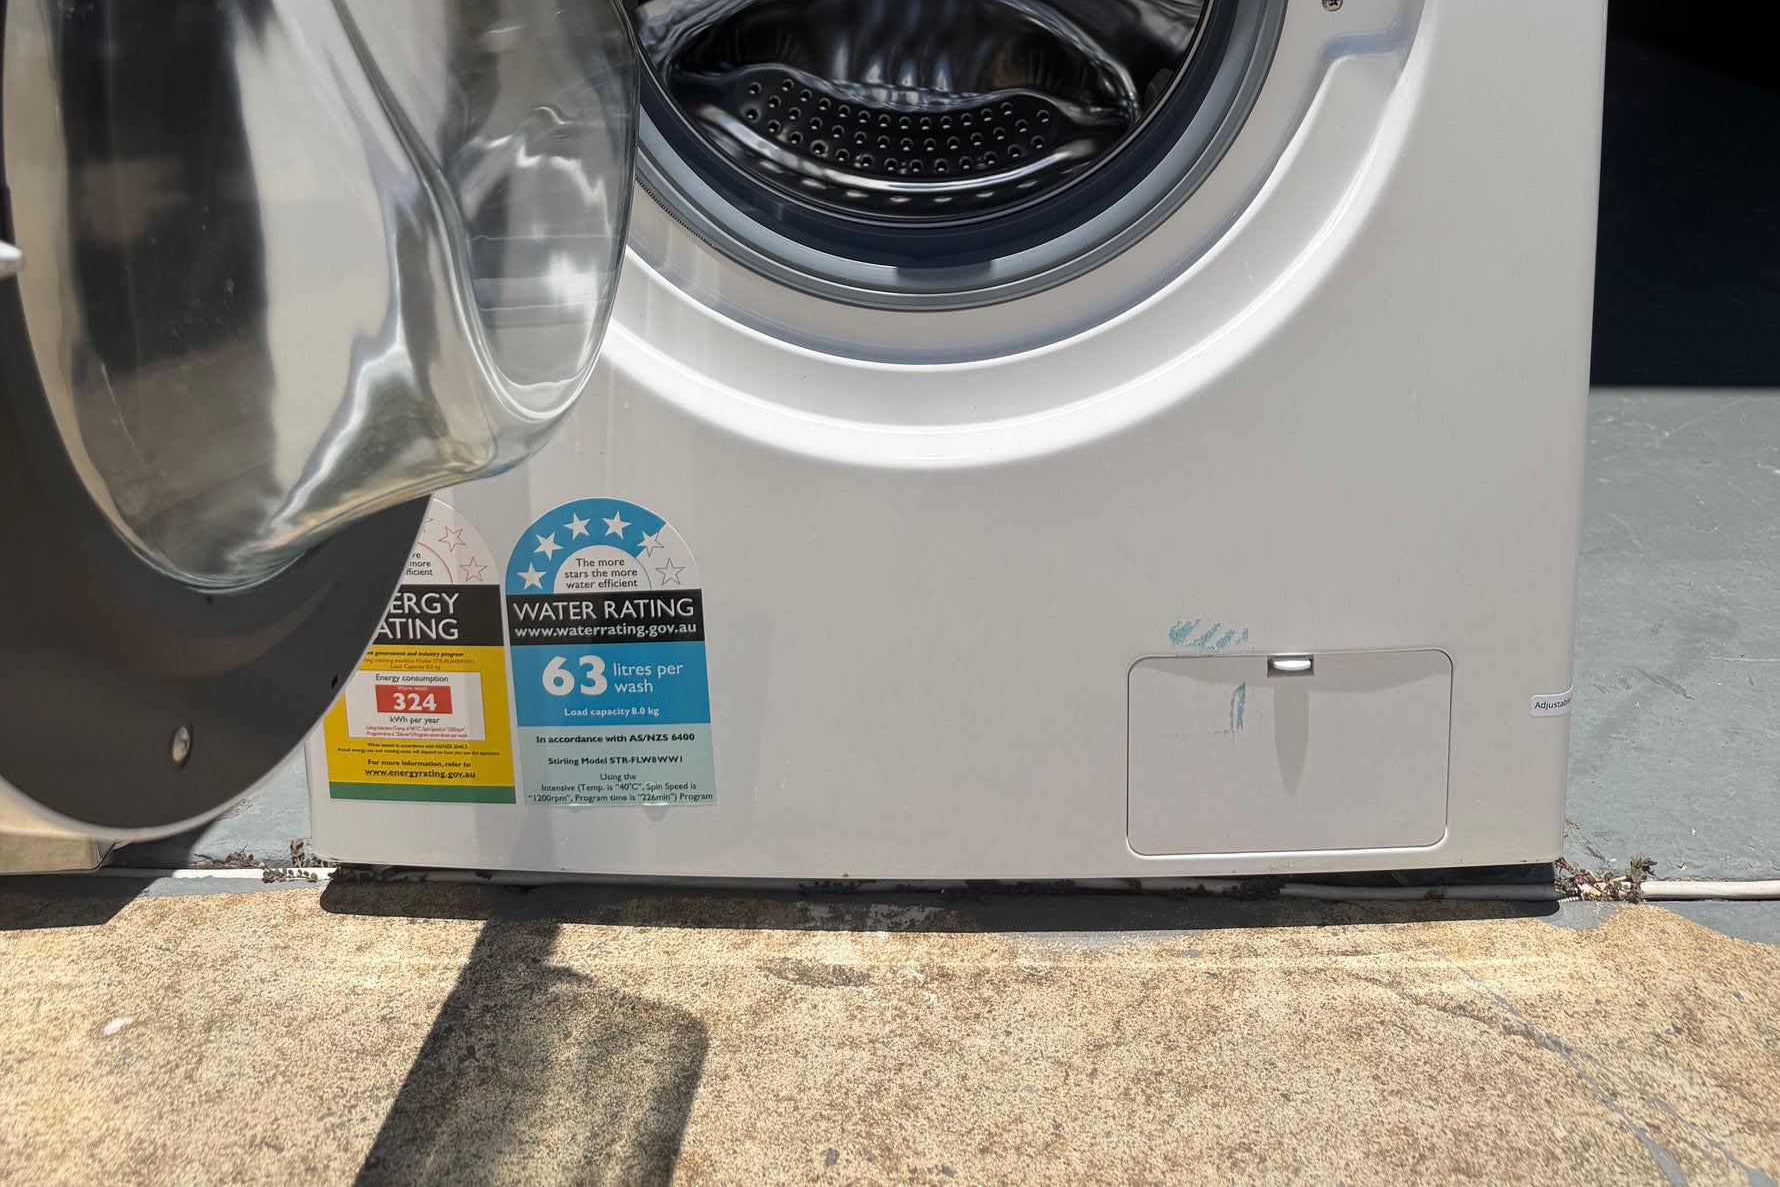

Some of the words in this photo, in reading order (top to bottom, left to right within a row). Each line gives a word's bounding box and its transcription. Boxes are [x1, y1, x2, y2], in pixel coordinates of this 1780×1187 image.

[576, 558, 597, 567] The
[598, 558, 624, 566] more
[564, 570, 589, 579] stars
[592, 569, 609, 578] the
[611, 569, 638, 577] more
[566, 580, 595, 589] water
[598, 579, 638, 587] efficient
[390, 593, 459, 614] ERGY
[513, 601, 597, 621] WATER
[604, 598, 694, 620] RATING
[379, 618, 458, 639] ATING
[515, 622, 697, 638] www.waterrating.gov.au
[376, 674, 400, 683] Energy
[402, 675, 448, 683] consumption
[542, 655, 608, 696] 63
[613, 662, 651, 676] litres
[657, 664, 683, 679] per
[614, 679, 653, 693] wash
[393, 693, 437, 711] 324
[564, 708, 588, 716] Load
[590, 708, 631, 717] capacity
[631, 707, 645, 715] 8.0
[648, 707, 659, 716] kg
[424, 717, 440, 725] year
[548, 735, 603, 743] accordance
[605, 735, 627, 743] with
[629, 734, 669, 742] AS/NZS
[672, 733, 695, 741] 6400
[548, 757, 579, 766] Stirling
[581, 757, 607, 765] Model
[365, 768, 476, 778] www.energyrating.gov.au
[600, 773, 622, 782] Using
[624, 773, 637, 781] the
[541, 784, 576, 792] Intensive
[646, 783, 663, 792] Spin
[665, 782, 688, 791] Speed
[575, 794, 608, 803] Program
[610, 793, 627, 801] time
[679, 792, 713, 802] Program
